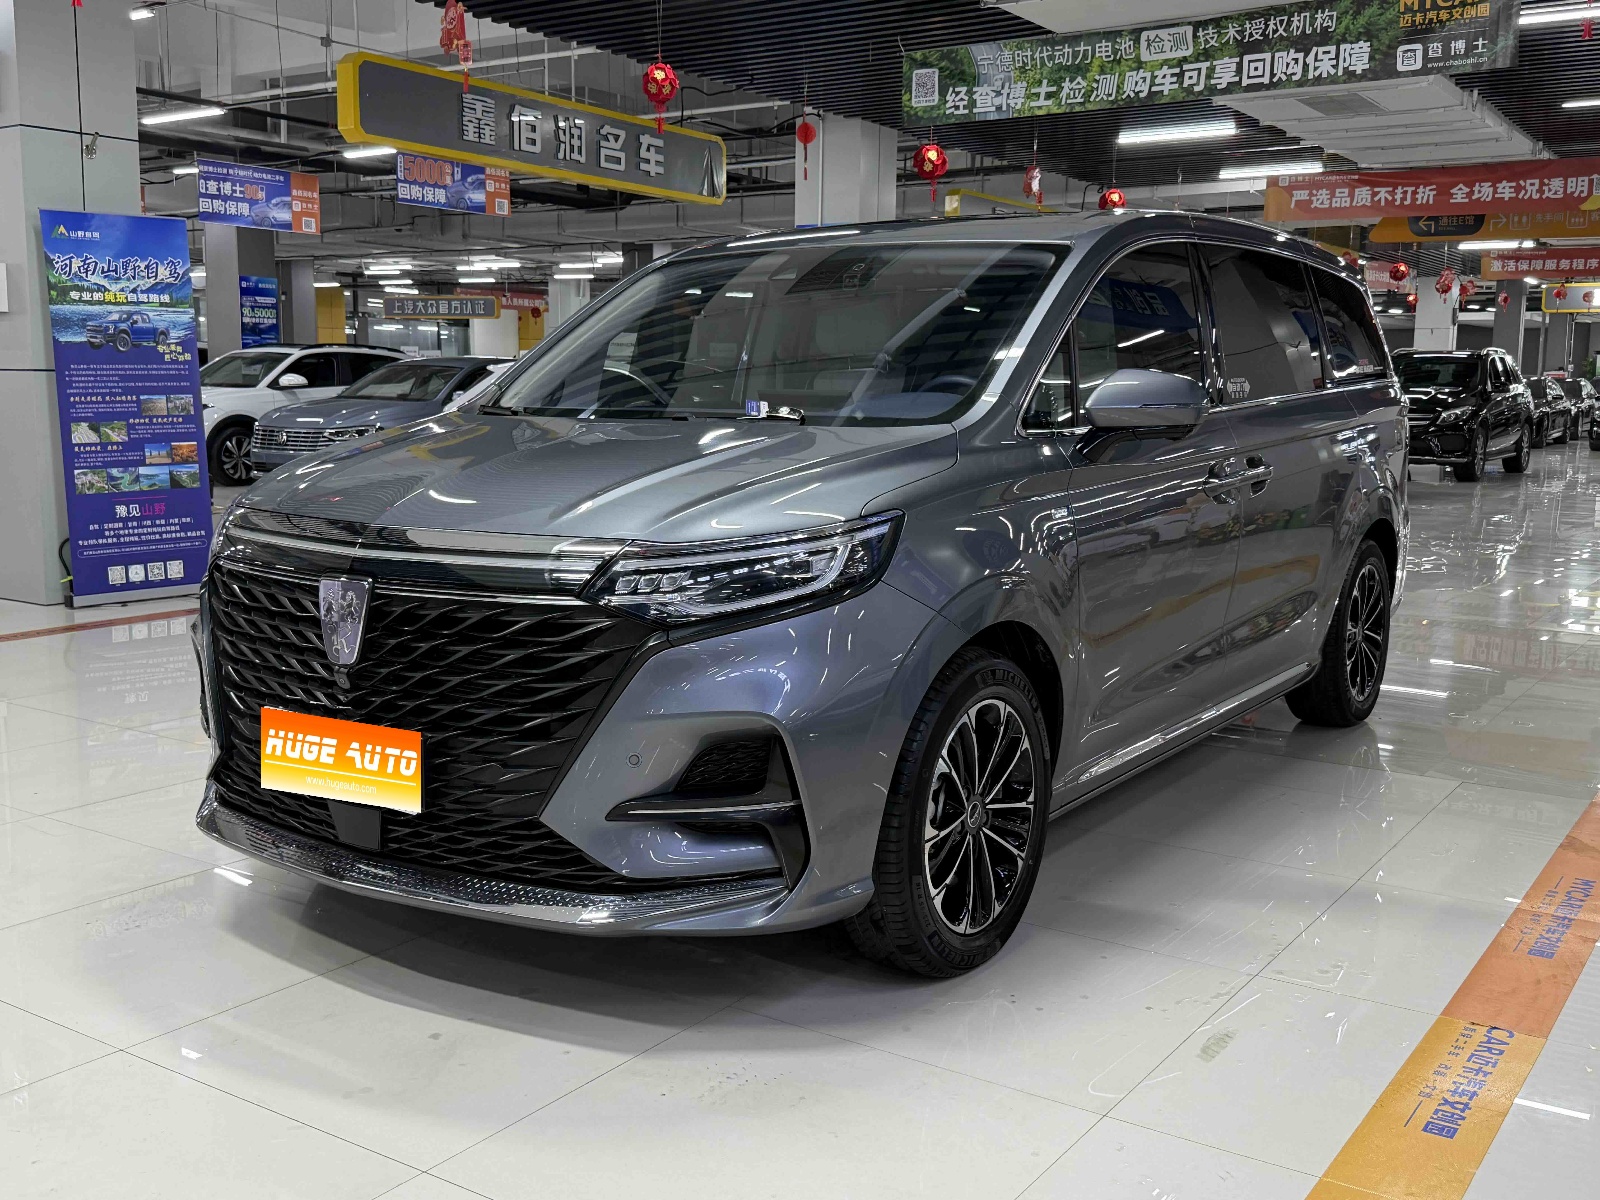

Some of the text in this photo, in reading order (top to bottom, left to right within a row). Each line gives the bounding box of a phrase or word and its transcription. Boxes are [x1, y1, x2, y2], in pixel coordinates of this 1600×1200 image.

[1400, 3, 1490, 27] 迈卡汽车文创园
[977, 8, 1337, 75] 宁德时代动力电池 检测 技术授权机构
[1427, 37, 1488, 58] 查博士
[1427, 56, 1488, 68] www.chaboshi.cn
[461, 92, 665, 178] 鑫佰润名车
[397, 183, 447, 204] 回购保障
[1290, 176, 1589, 210] 严选品质不打折 全场车况透明
[199, 198, 251, 217] 回购保障
[53, 253, 183, 283] 河南山野自驾
[1490, 258, 1600, 272] 激活保障服务程序
[69, 290, 171, 304] 专业的纯玩自驾路线
[393, 300, 486, 315] 上汽大众官方认证
[115, 503, 166, 518] 豫见山野
[994, 669, 1038, 709] MICHELIN
